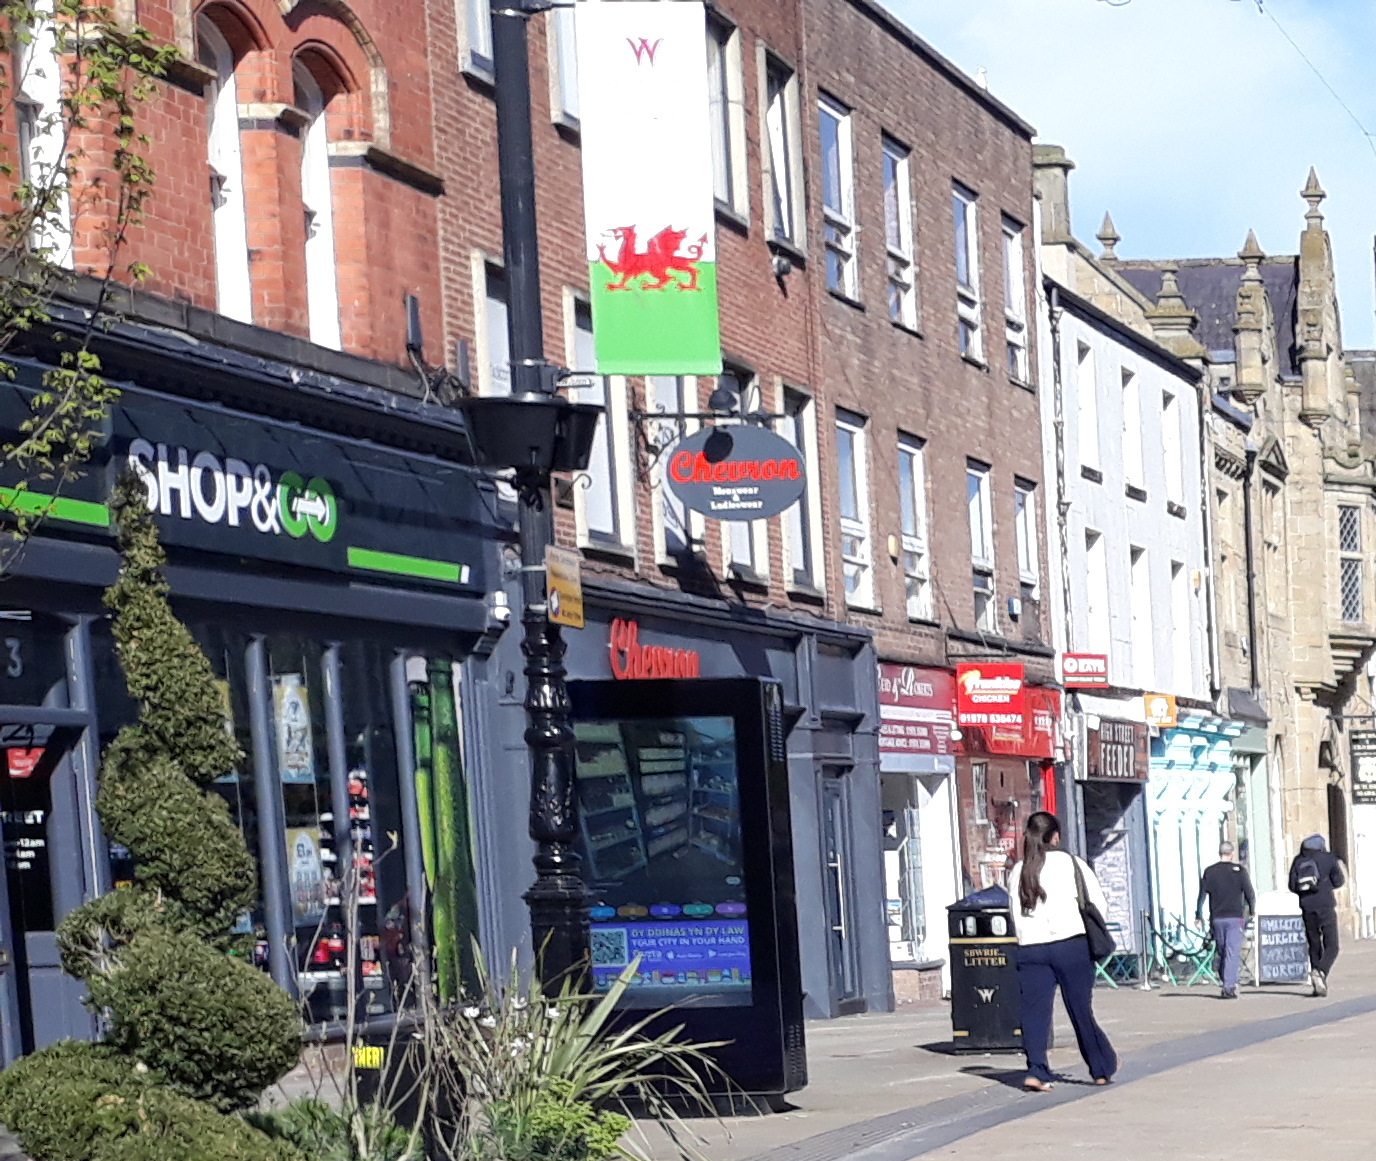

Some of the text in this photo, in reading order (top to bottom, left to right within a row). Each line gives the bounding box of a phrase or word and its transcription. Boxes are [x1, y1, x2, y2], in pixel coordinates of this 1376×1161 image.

[669, 450, 800, 483] Chevron
[658, 938, 678, 947] CITY
[692, 937, 716, 945] YOUR
[718, 936, 745, 945] HAND
[964, 957, 1007, 966] LITTER
